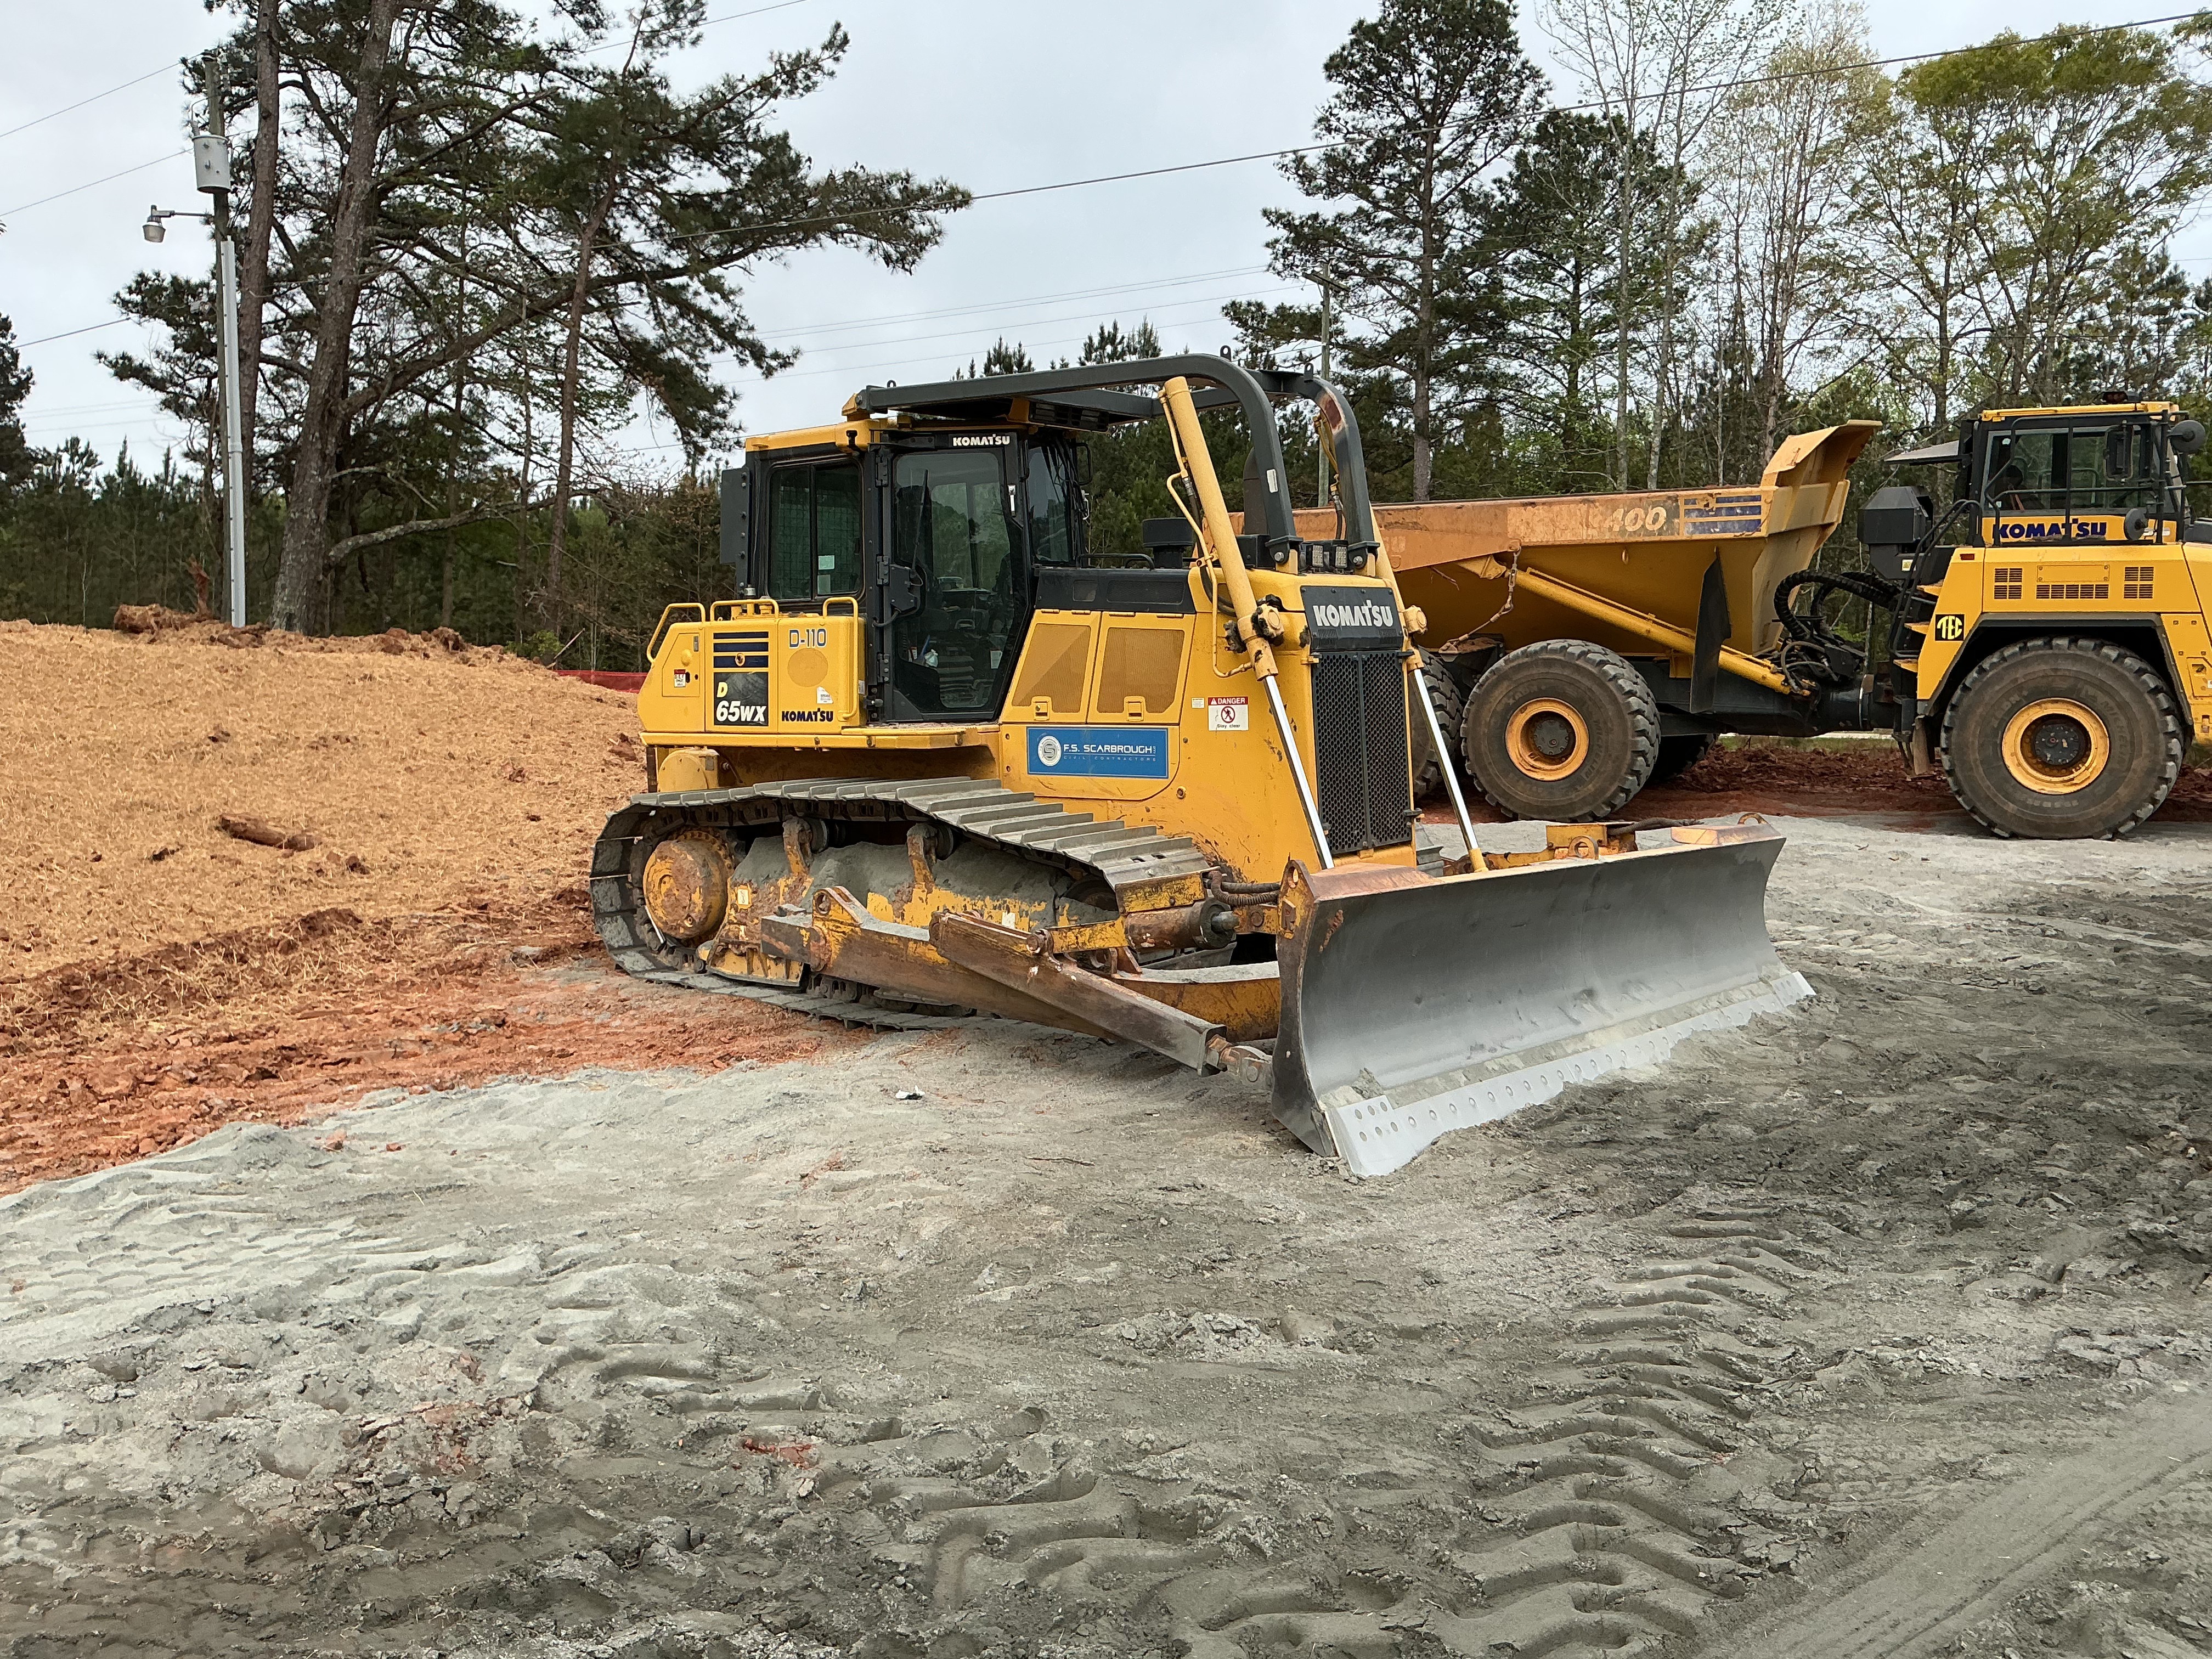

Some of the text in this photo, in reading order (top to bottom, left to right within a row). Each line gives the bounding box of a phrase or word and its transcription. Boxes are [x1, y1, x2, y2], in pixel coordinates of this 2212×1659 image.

[953, 434, 1010, 447] KOMATSU
[1313, 600, 1393, 627] KOMATSU
[1937, 616, 1962, 639] TEC
[789, 628, 827, 648] D-110
[716, 681, 728, 698] D
[716, 700, 766, 722] 65WX
[782, 708, 833, 722] KOMATSU
[1063, 744, 1152, 753] F.S. SCARBROUGH
